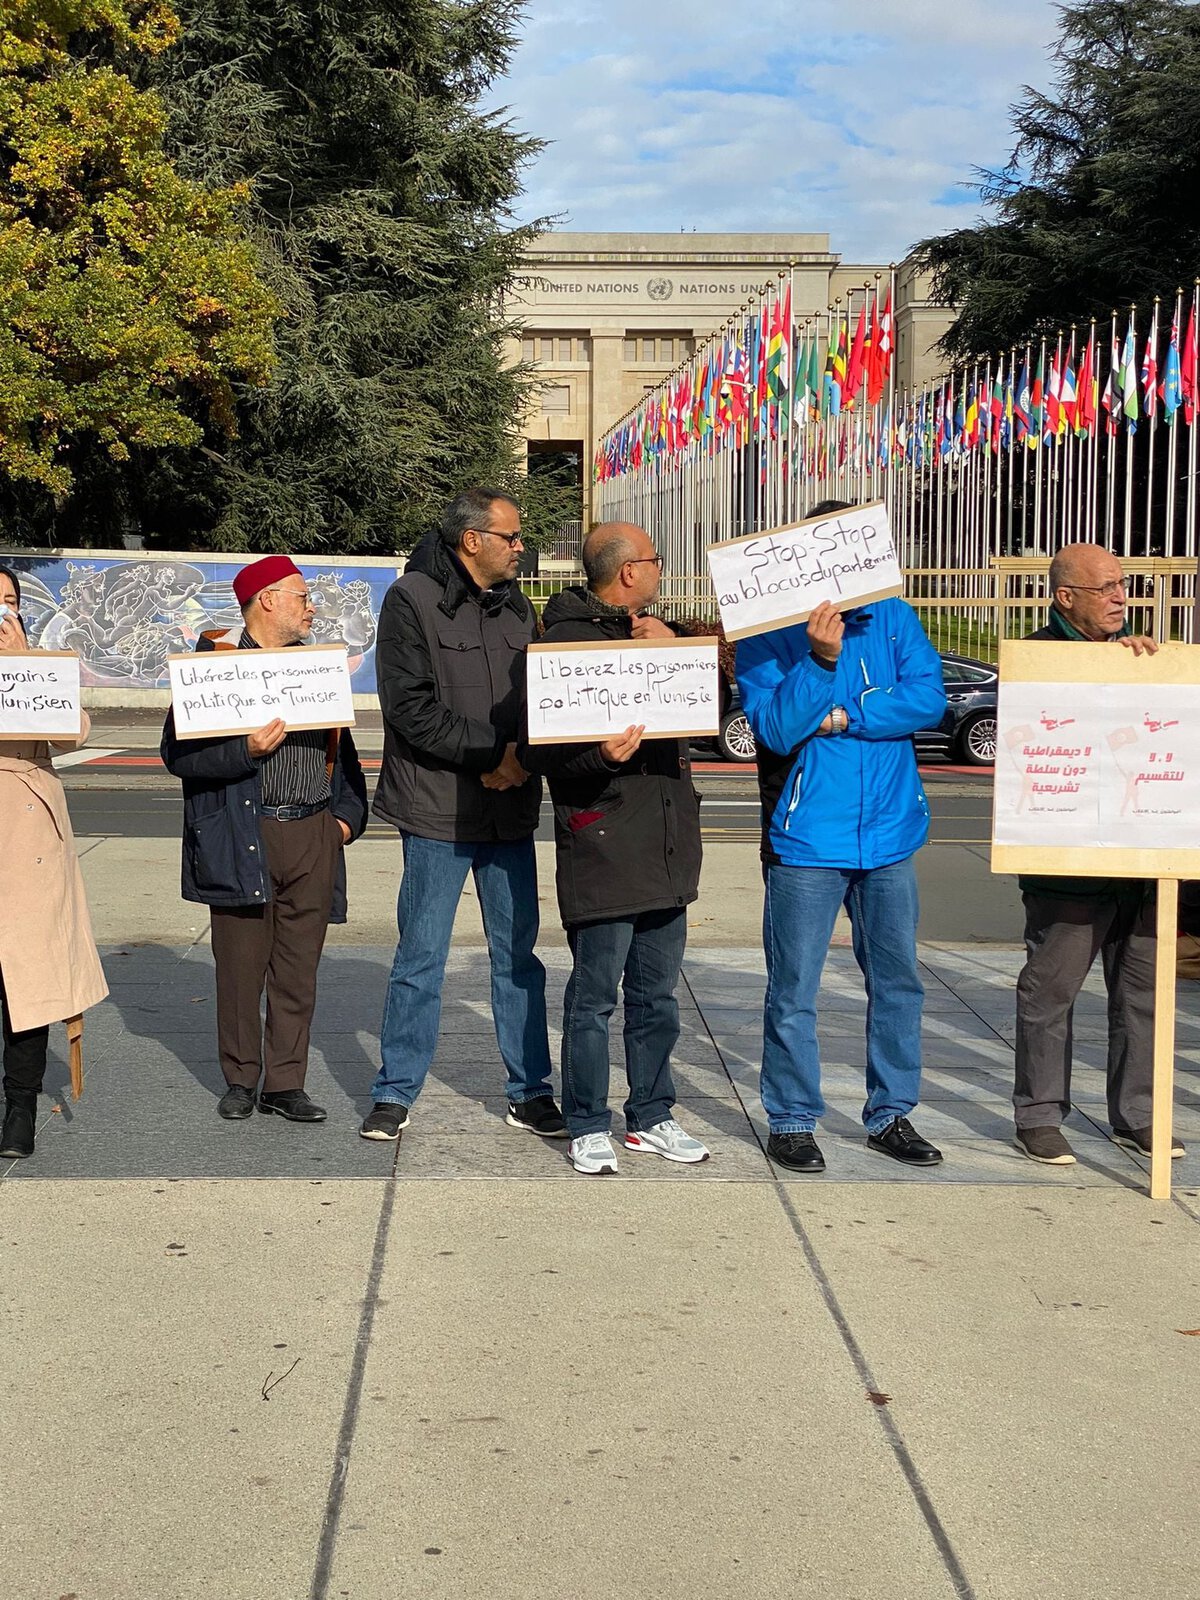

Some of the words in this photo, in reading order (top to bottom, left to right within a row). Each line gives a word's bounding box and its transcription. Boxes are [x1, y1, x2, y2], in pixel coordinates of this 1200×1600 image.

[542, 283, 583, 293] UNITED
[586, 283, 640, 293] NATIONS
[679, 284, 736, 294] NATIONS
[179, 667, 235, 687] Libérez
[260, 664, 344, 690] prisonniers
[539, 655, 616, 680] Libérez
[646, 658, 717, 689] prisonniers
[262, 694, 281, 706] en
[281, 685, 340, 706] Tunisie
[633, 691, 651, 705] en
[651, 675, 713, 708] Tunisie
[1022, 745, 1082, 759] ديمقراطية
[1084, 745, 1092, 757] لا
[1148, 752, 1157, 763] لا
[1165, 752, 1174, 763] لا
[1025, 763, 1061, 775] سلطة
[1062, 764, 1087, 777] دون
[1134, 770, 1185, 786] للتقسيم
[1031, 780, 1081, 795] تشريعية
